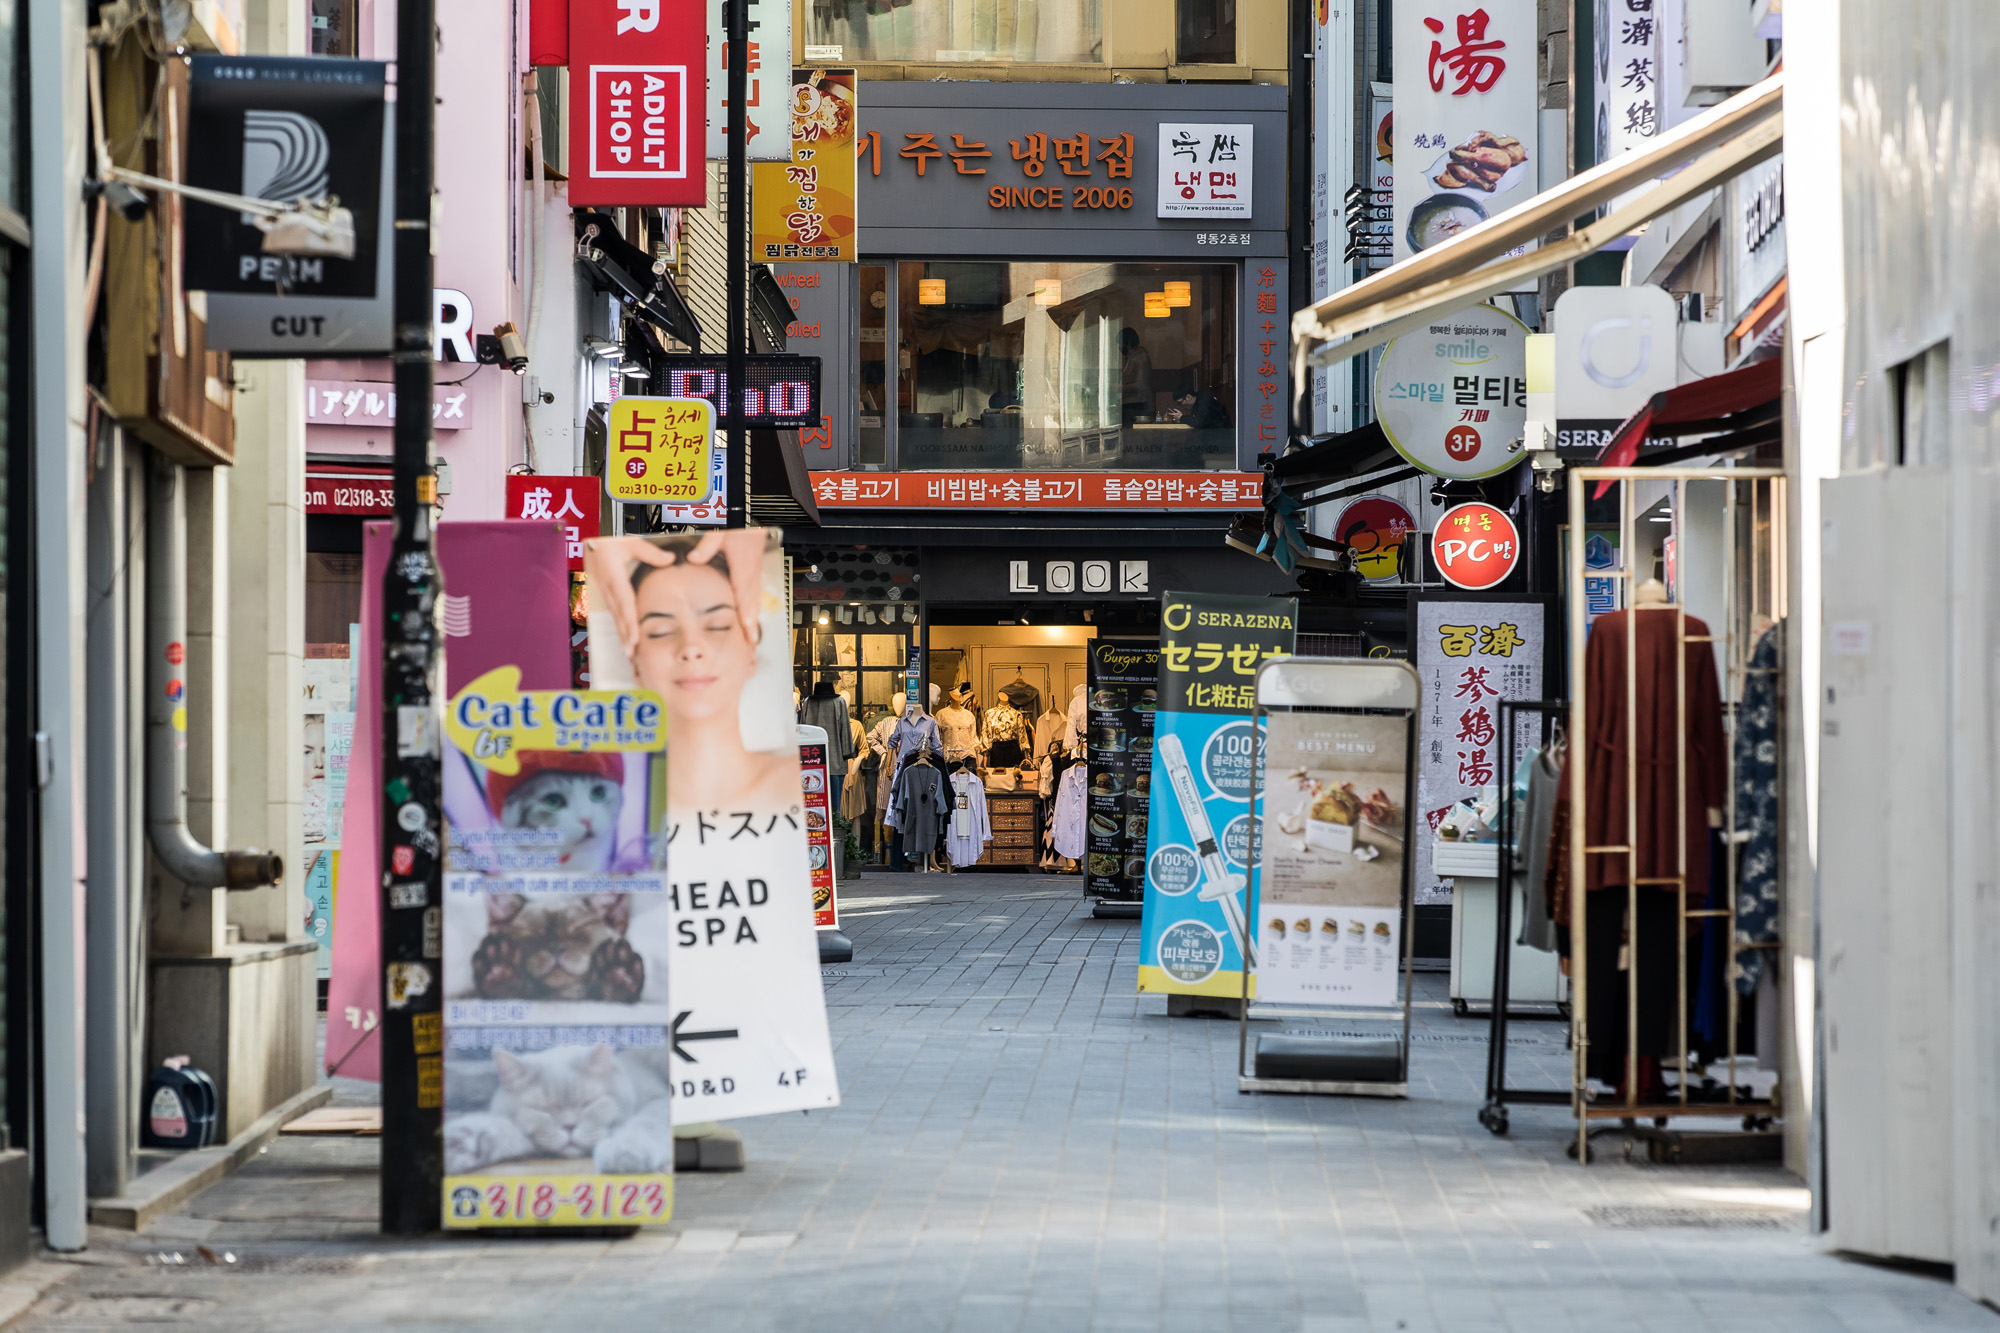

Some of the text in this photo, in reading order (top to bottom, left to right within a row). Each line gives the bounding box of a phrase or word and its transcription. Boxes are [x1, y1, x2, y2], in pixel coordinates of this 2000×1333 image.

[1423, 7, 1506, 96] 湯
[610, 80, 633, 165] SHOP
[643, 73, 666, 170] ADULT
[899, 131, 993, 177] 주는
[1008, 131, 1136, 179] 냉면집
[988, 185, 1135, 210] SINCE 2006
[1376, 207, 1394, 219] Gl
[1196, 233, 1251, 246] 명동2호점
[765, 243, 840, 258] 찜닭전문점
[774, 270, 820, 288] wheat
[271, 316, 327, 337] CUT
[1434, 338, 1491, 360] smile
[1388, 382, 1445, 403] 스마일
[663, 406, 701, 430] 운세
[1457, 408, 1491, 423] 카페
[619, 410, 656, 453] 占
[1557, 429, 1676, 449] SERANA
[659, 431, 704, 459] 작명
[1450, 434, 1476, 453] 3F
[627, 461, 646, 475] 3F
[664, 460, 699, 482] 타로
[618, 483, 697, 497] 02)310-9270
[927, 478, 1083, 502] 비빔밥+숯불고기
[1102, 478, 1264, 502] 돌솥알밥+숯불고
[520, 486, 586, 520] 成人
[1453, 512, 1493, 533] 명동
[1010, 561, 1149, 593] LOOK
[1197, 612, 1293, 630] SERAZENA
[458, 693, 660, 730] Cat Cafe
[473, 730, 513, 759] 6F
[1157, 852, 1195, 868] 100%
[677, 916, 758, 947] SPA
[1172, 928, 1212, 940] アトピーの
[1162, 946, 1218, 964] 피부보호
[776, 1068, 808, 1088] 4F
[486, 1182, 664, 1219] 318-3123
